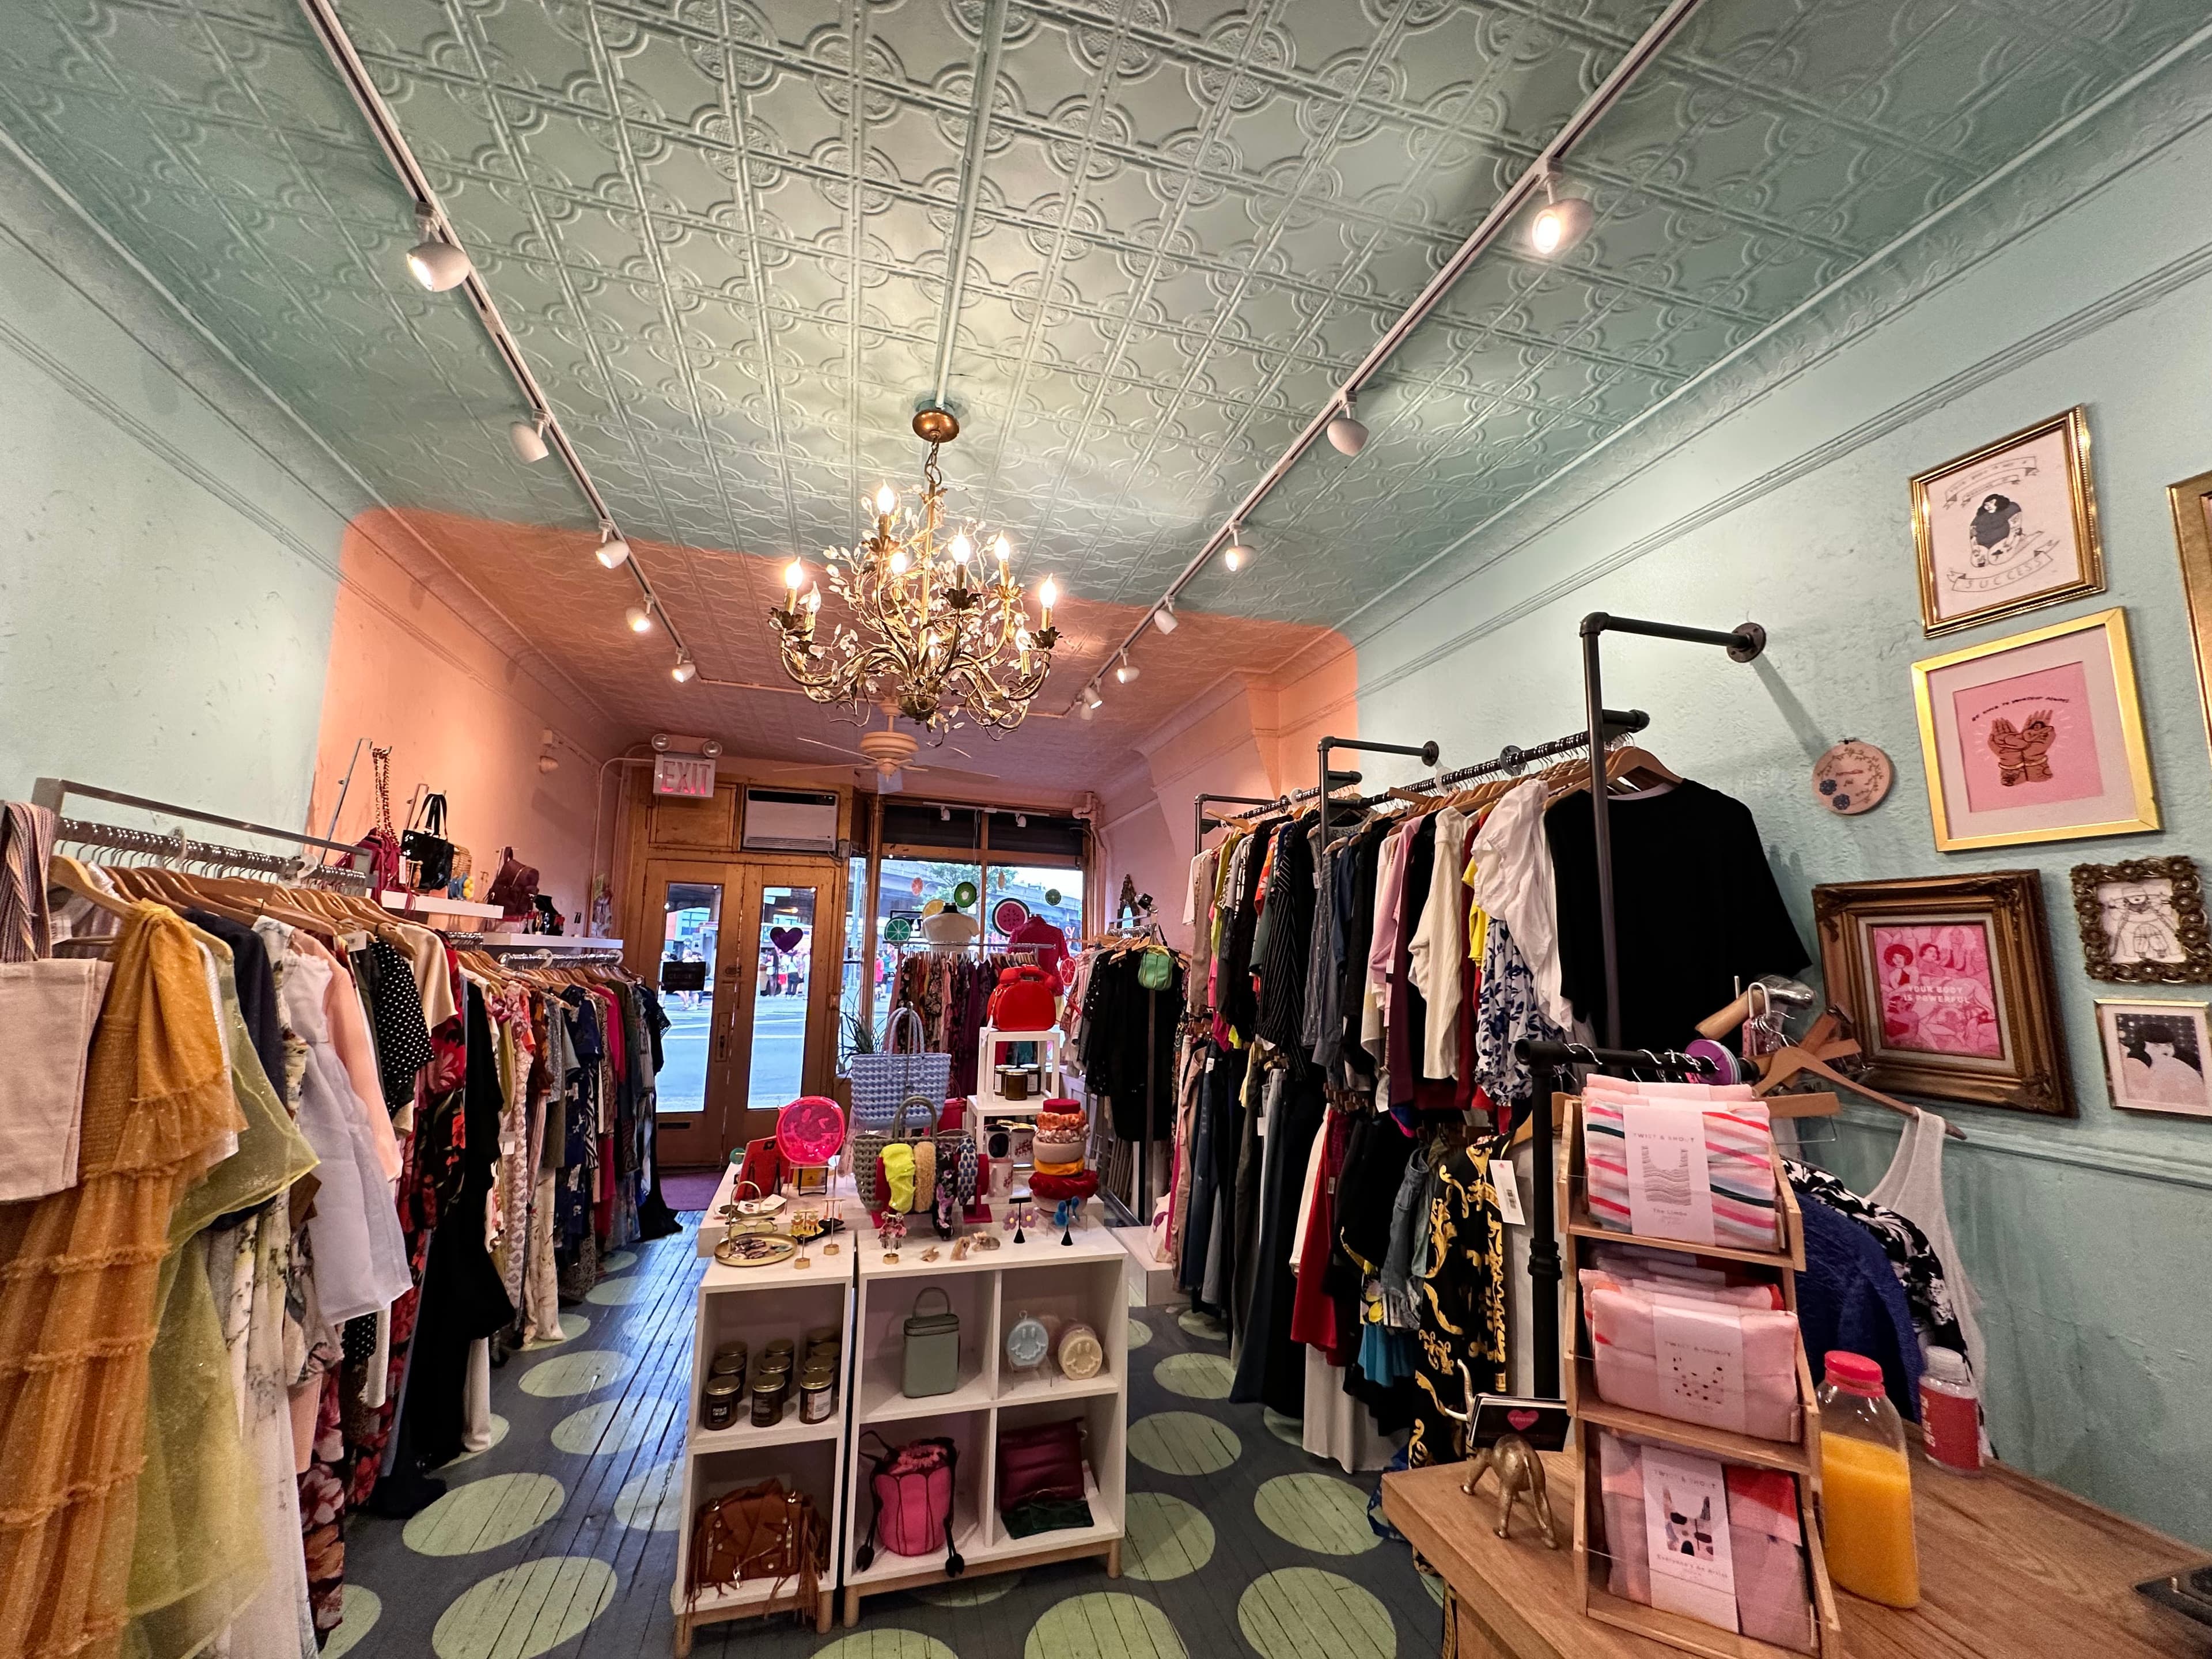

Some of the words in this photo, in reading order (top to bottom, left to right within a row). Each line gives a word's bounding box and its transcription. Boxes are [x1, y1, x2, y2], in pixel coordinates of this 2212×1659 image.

[1965, 558, 2041, 589] SUCCESS
[661, 760, 711, 794] EXIT
[1915, 994, 1971, 1003] POWERFUL
[1936, 986, 1963, 994] BODY
